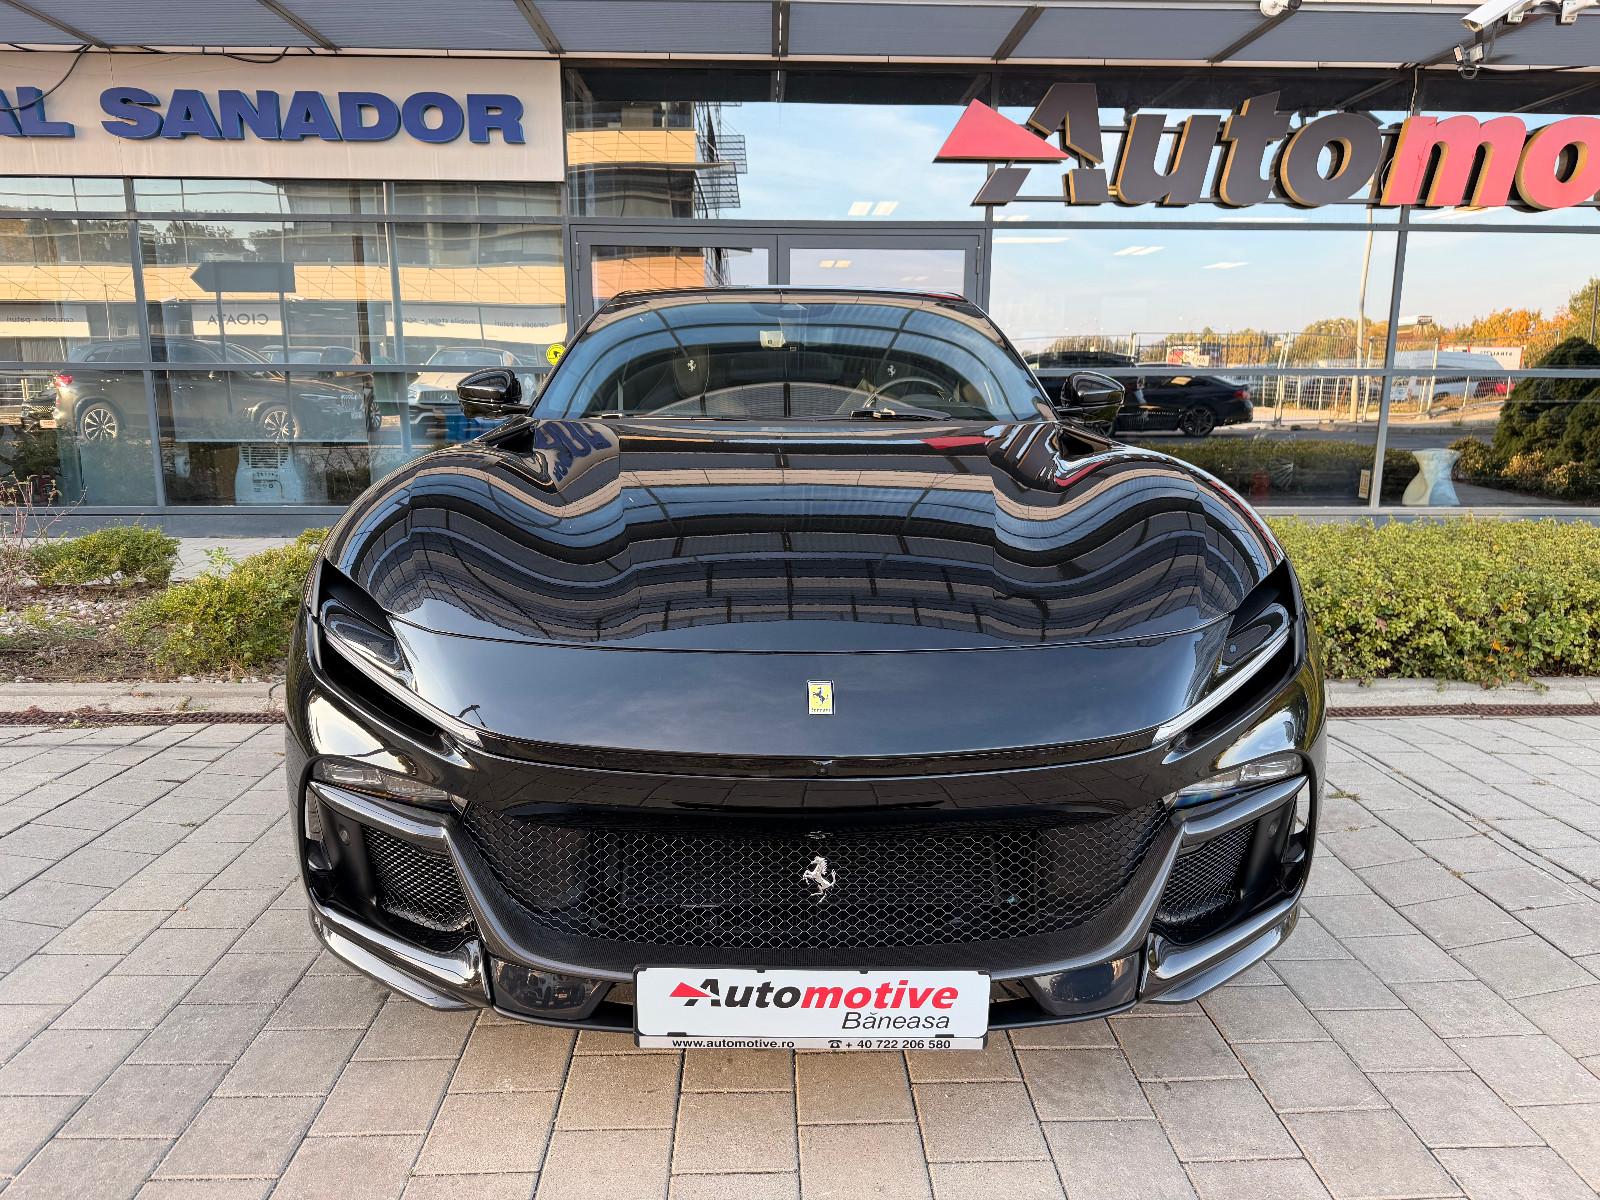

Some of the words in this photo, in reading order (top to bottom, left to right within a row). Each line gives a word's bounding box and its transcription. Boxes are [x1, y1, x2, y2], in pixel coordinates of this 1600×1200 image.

[99, 86, 526, 145] SANADOR
[669, 978, 959, 1009] Automotive
[841, 1012, 950, 1030] Băneasa
[672, 1038, 795, 1049] www.automotive.ro
[876, 1039, 898, 1049] 722
[902, 1039, 925, 1049] 206
[928, 1039, 951, 1049] 580
